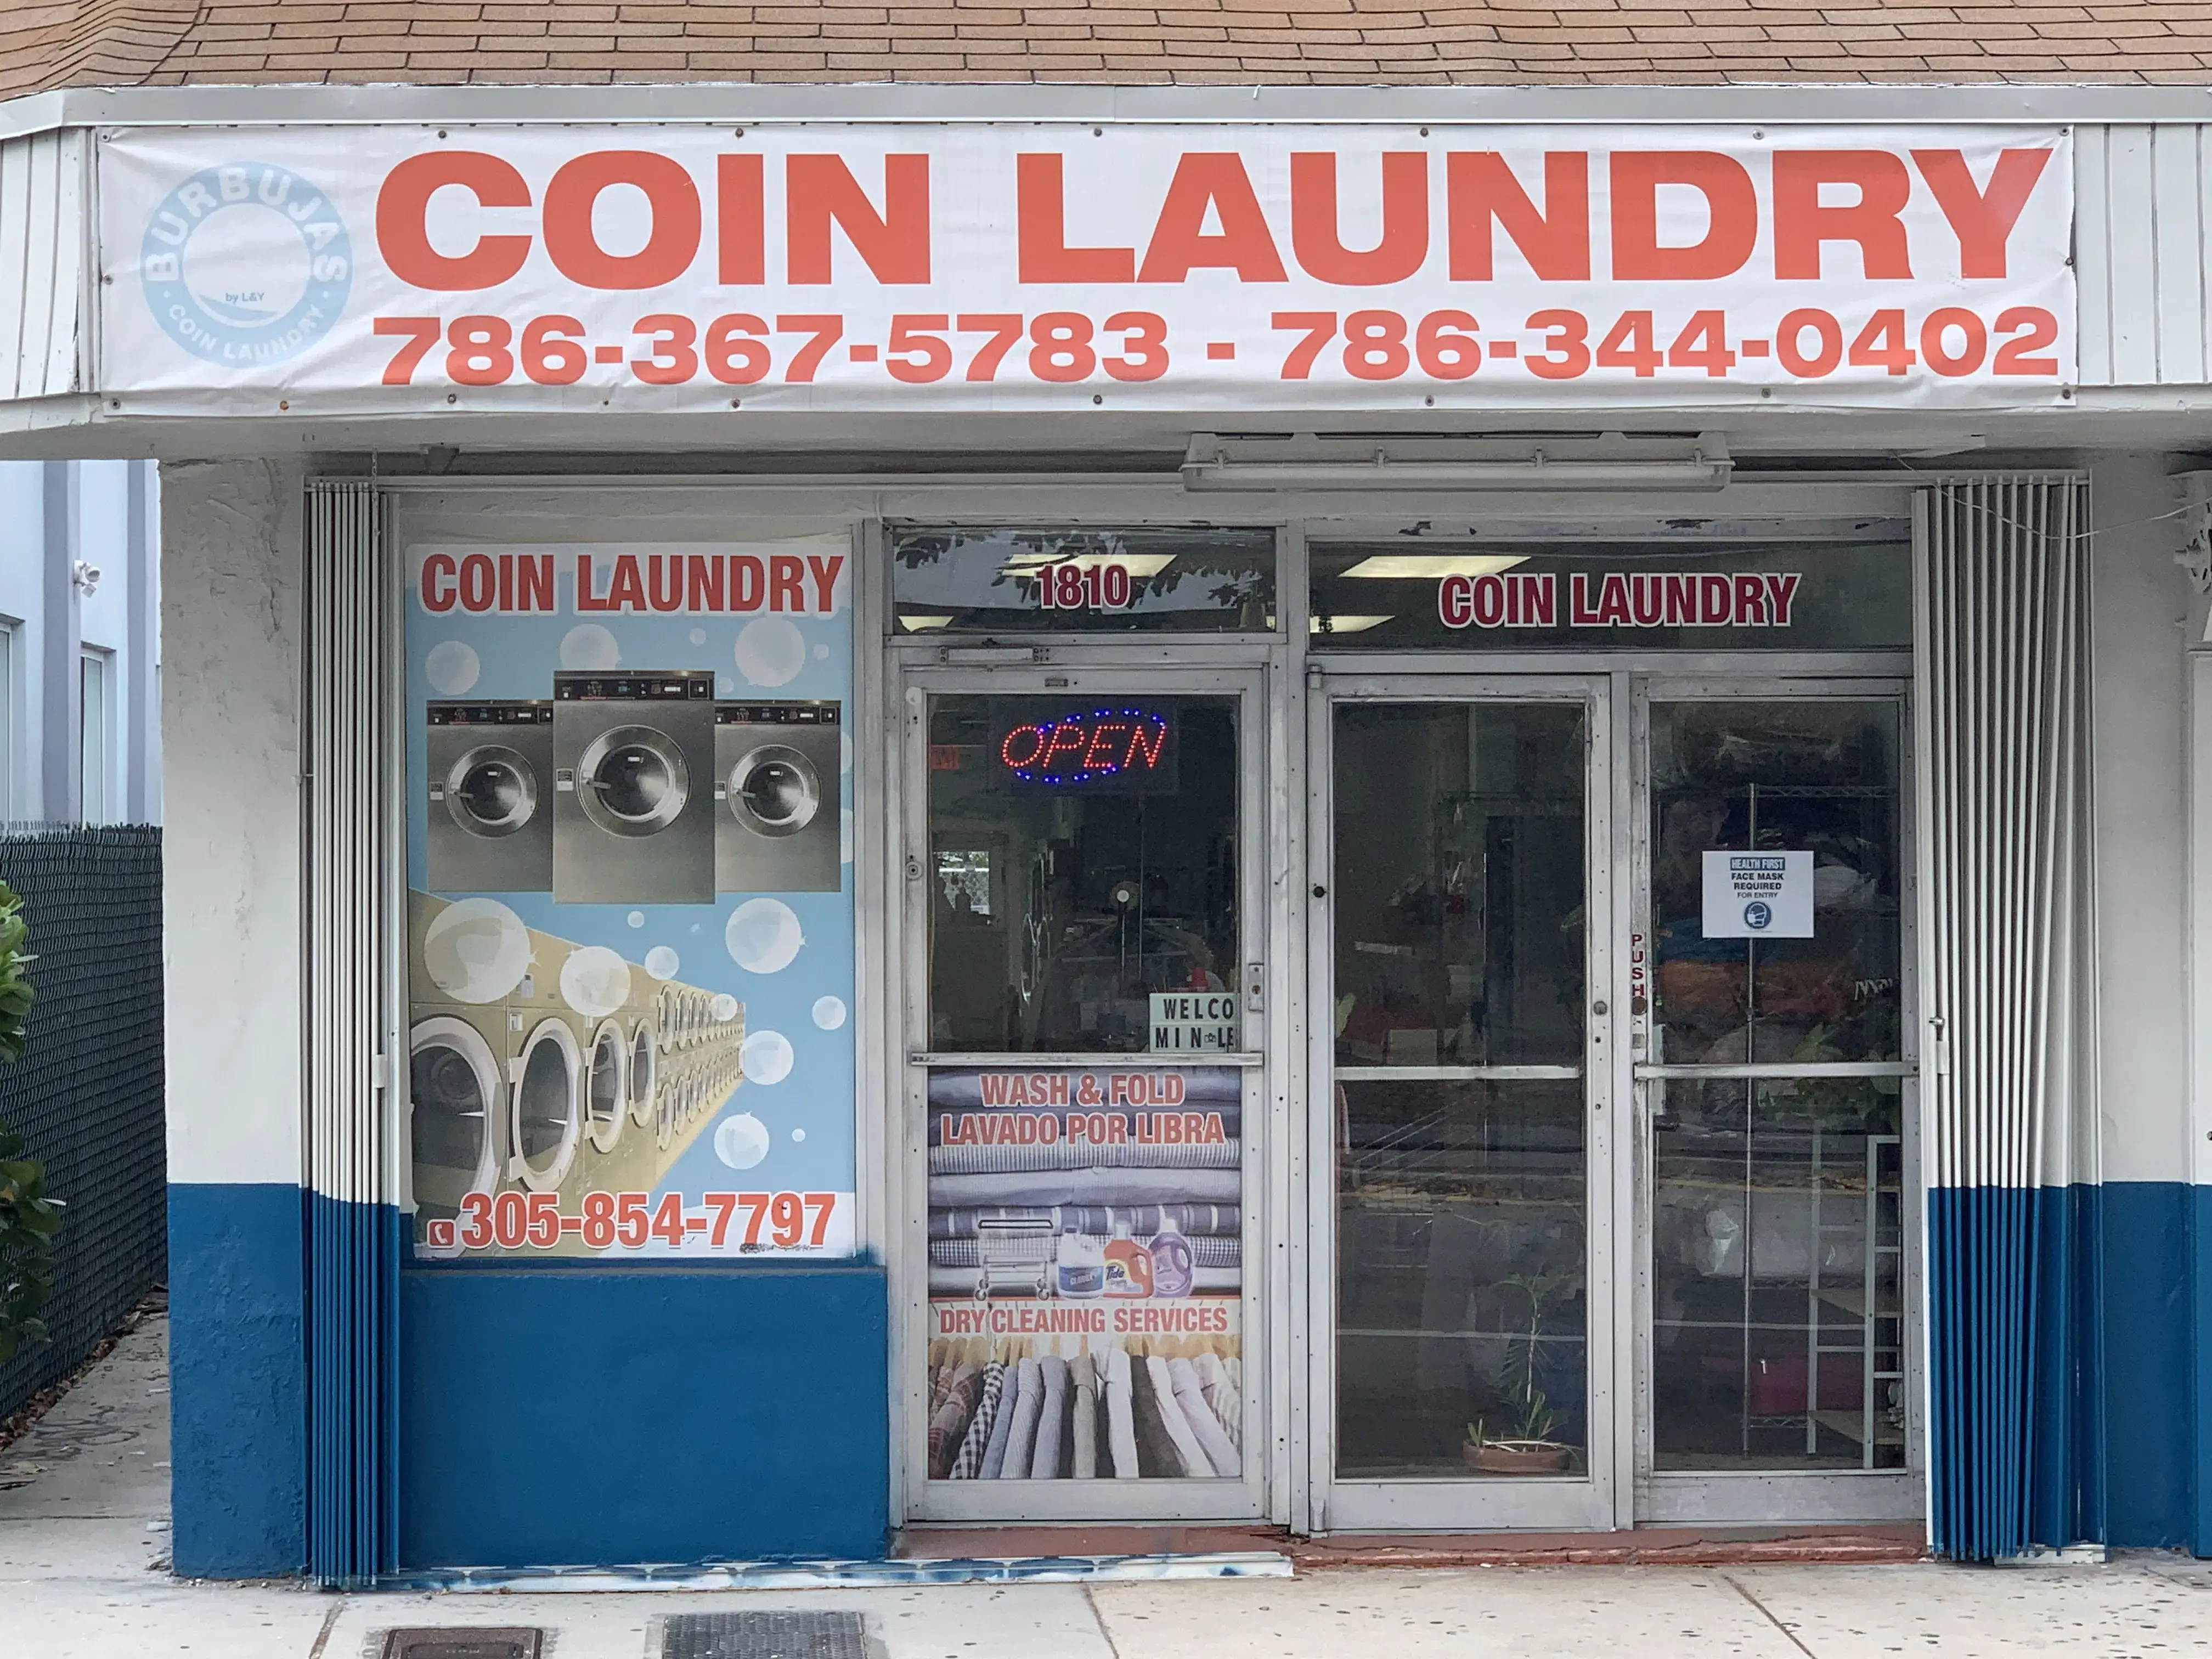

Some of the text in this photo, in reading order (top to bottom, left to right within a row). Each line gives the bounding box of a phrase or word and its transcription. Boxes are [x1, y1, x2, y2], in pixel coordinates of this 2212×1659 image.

[146, 166, 348, 283] BURBUJAS
[376, 149, 2052, 291] COIN LAUNDRY
[225, 291, 264, 303] by L&Y
[168, 303, 325, 360] COIN LAUNDRY
[374, 311, 1169, 386] 786-367-5783
[1272, 307, 2058, 380] 786-344-0402
[421, 554, 844, 612] COIN LAUNDRY
[1036, 564, 1128, 606] 1810
[1441, 575, 1797, 625] COIN LAUNDRY
[1001, 725, 1167, 768] OPEN
[1731, 859, 1784, 869] HEALTH FIRST
[1632, 934, 1645, 997] PUSH
[981, 1074, 1184, 1105] WASH & FOLD
[943, 1114, 1224, 1145] LAVADO POR LIBRA
[462, 1192, 836, 1247] 305-854-7797
[1105, 1266, 1125, 1281] Tide
[940, 1307, 1228, 1333] DRY CLEANING SERVICES
